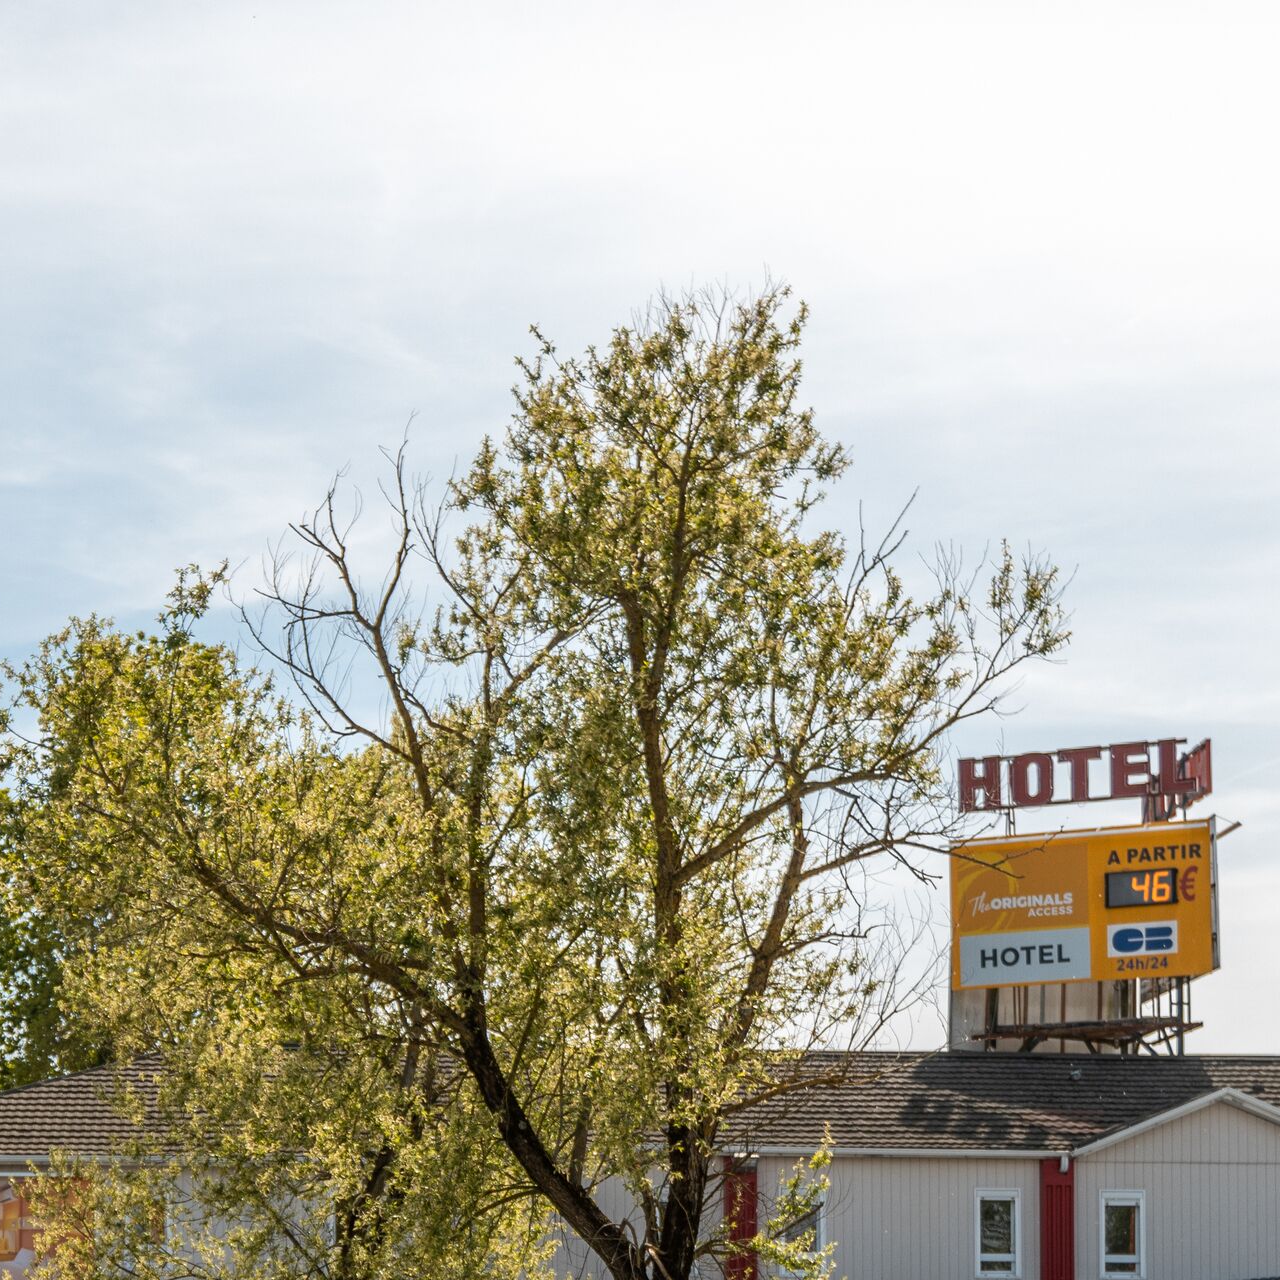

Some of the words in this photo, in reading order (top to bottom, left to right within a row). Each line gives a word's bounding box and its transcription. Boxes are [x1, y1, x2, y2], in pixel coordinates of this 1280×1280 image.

[958, 738, 1198, 812] HOTEL
[1127, 843, 1202, 863] PARTIR
[1131, 871, 1171, 903] 46
[990, 892, 1073, 911] ORIGINALS
[1027, 906, 1073, 917] ACCESS
[980, 944, 1071, 969] HOTEL
[1116, 957, 1168, 972] 24h/24
